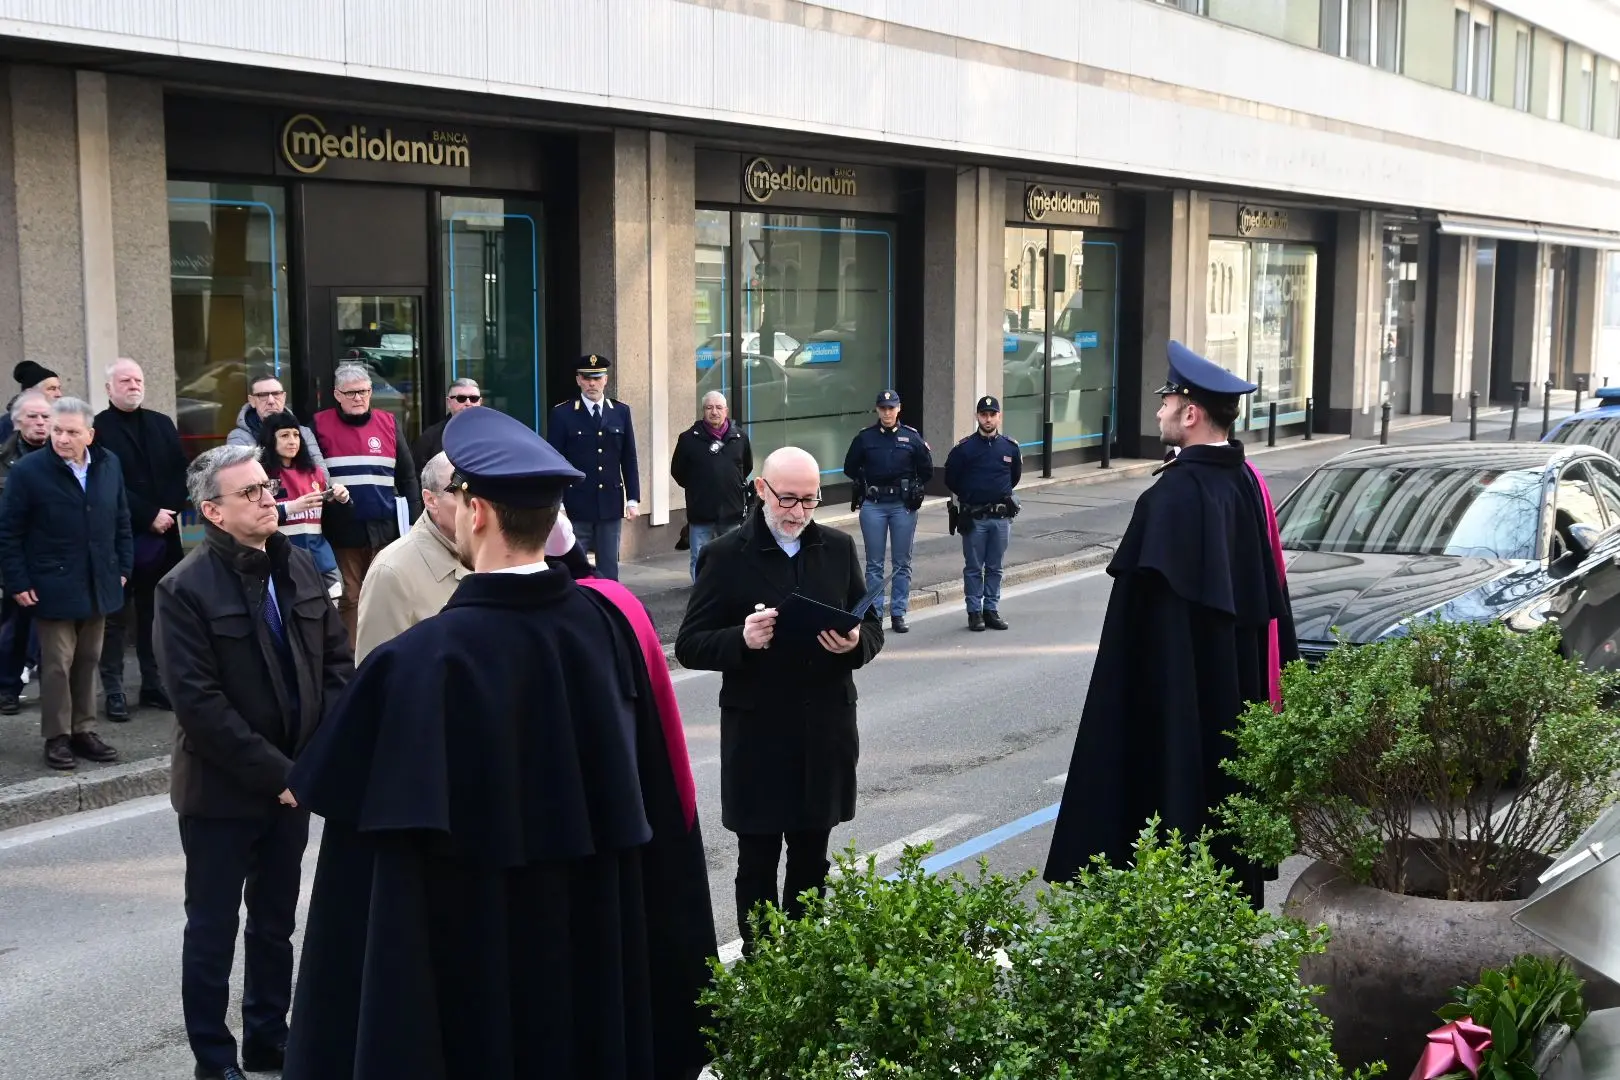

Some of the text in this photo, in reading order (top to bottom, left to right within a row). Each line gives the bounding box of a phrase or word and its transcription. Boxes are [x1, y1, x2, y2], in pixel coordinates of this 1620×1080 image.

[291, 125, 471, 167] mediolanum
[432, 130, 469, 144] BANCA
[752, 164, 857, 196] mediolanum
[834, 167, 856, 178] BANCA
[1033, 190, 1100, 215] mediolanum
